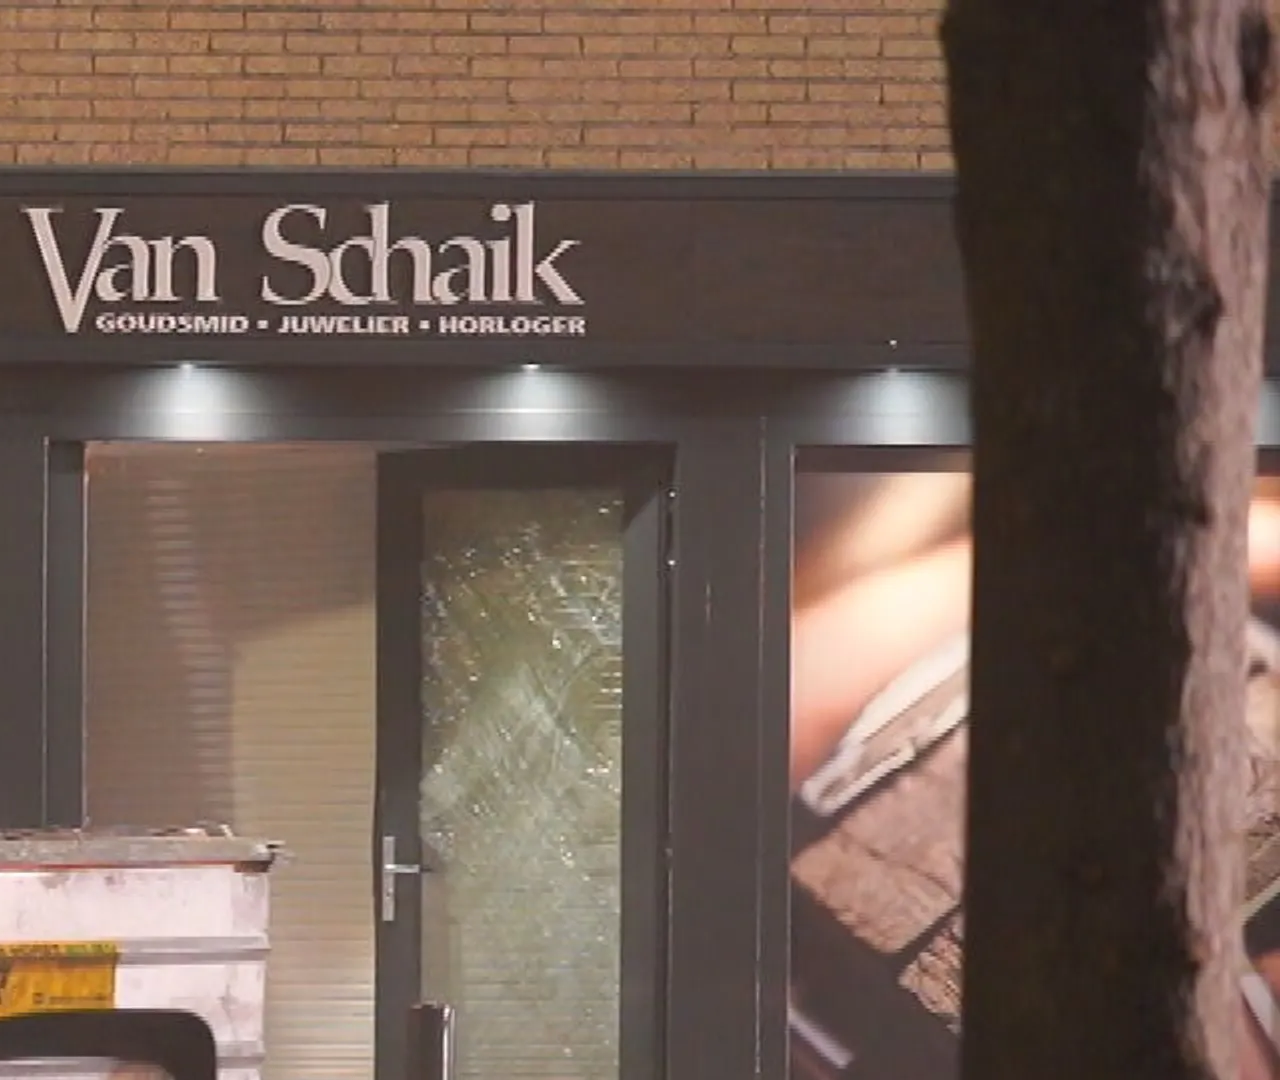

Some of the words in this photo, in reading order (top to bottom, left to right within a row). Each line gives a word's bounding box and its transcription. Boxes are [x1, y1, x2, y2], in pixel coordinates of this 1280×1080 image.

[22, 205, 221, 333] Van
[261, 201, 585, 305] Schaik
[95, 313, 250, 334] GOUDSMID
[277, 314, 410, 334] JUWELIER
[439, 314, 586, 335] HORLOGER
